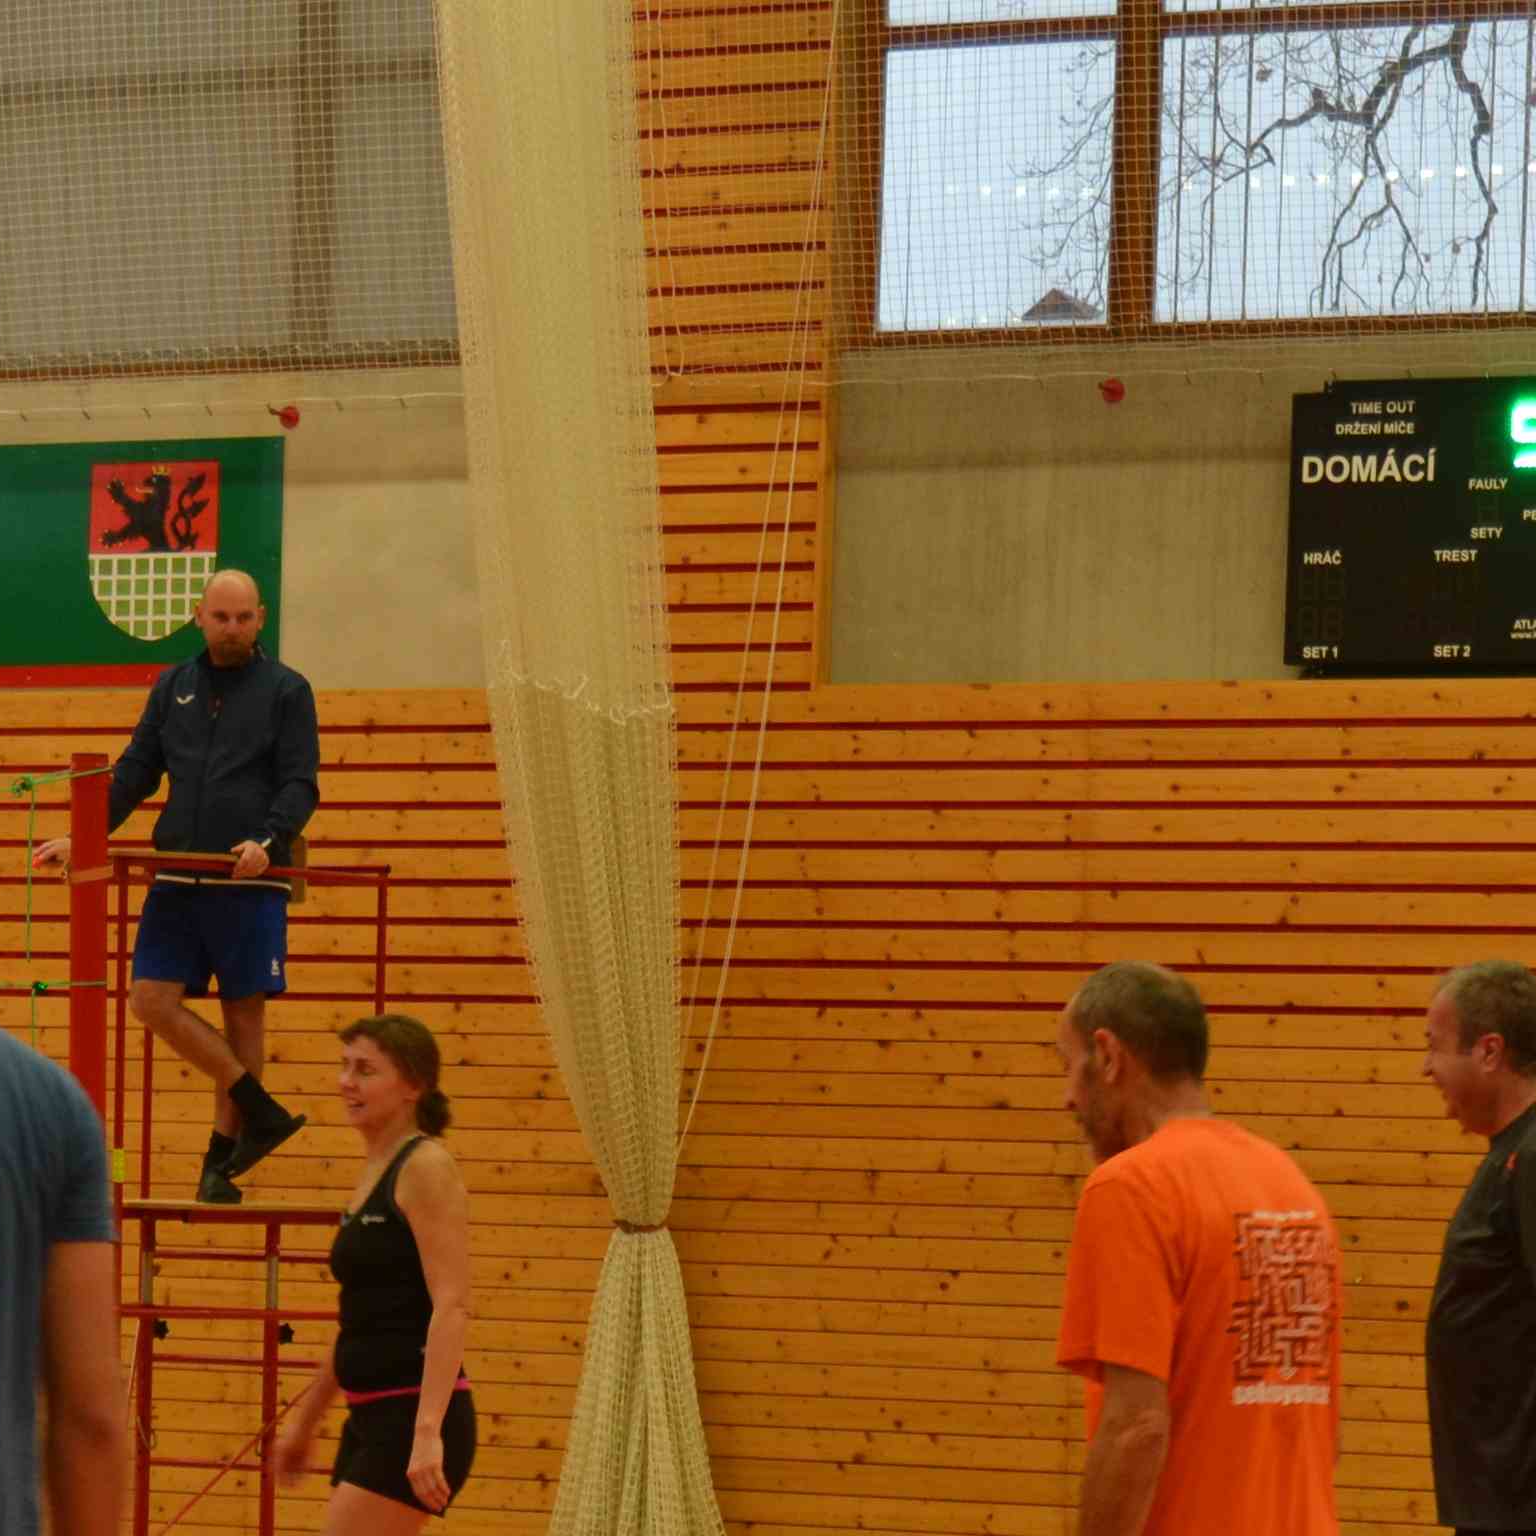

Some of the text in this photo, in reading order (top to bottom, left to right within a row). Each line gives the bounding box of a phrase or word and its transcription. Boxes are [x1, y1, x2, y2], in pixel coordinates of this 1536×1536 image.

[1350, 400, 1416, 415] TIME OUT
[1335, 420, 1415, 435] DRŽENÍ MÍČE
[1301, 447, 1437, 484] DOMÁCÍ
[1468, 477, 1509, 491] FAULY
[1470, 526, 1503, 540] SETY
[1303, 549, 1342, 565] HRÁČ
[1433, 548, 1478, 563] TREST
[1302, 645, 1339, 660] SET 1
[1433, 644, 1472, 659] SET 2
